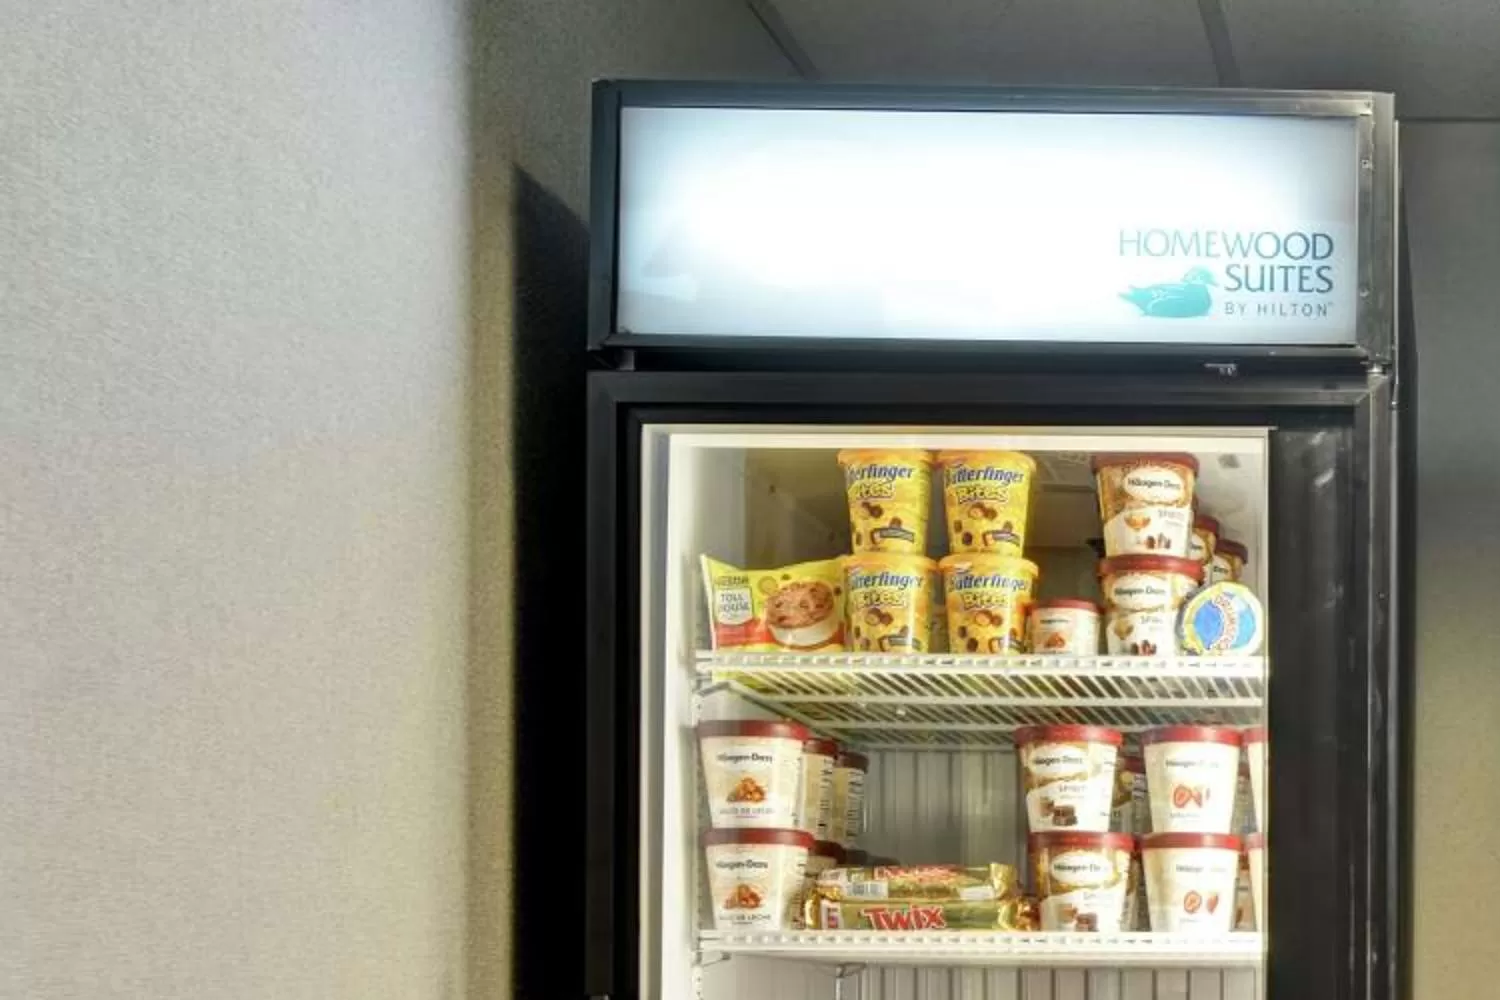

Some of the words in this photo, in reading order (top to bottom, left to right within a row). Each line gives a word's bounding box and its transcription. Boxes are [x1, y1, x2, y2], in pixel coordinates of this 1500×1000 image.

[1118, 229, 1335, 261] HOMEWOOD
[1223, 263, 1334, 294] SUITES
[1224, 303, 1246, 316] BY
[1257, 303, 1329, 317] HILTON
